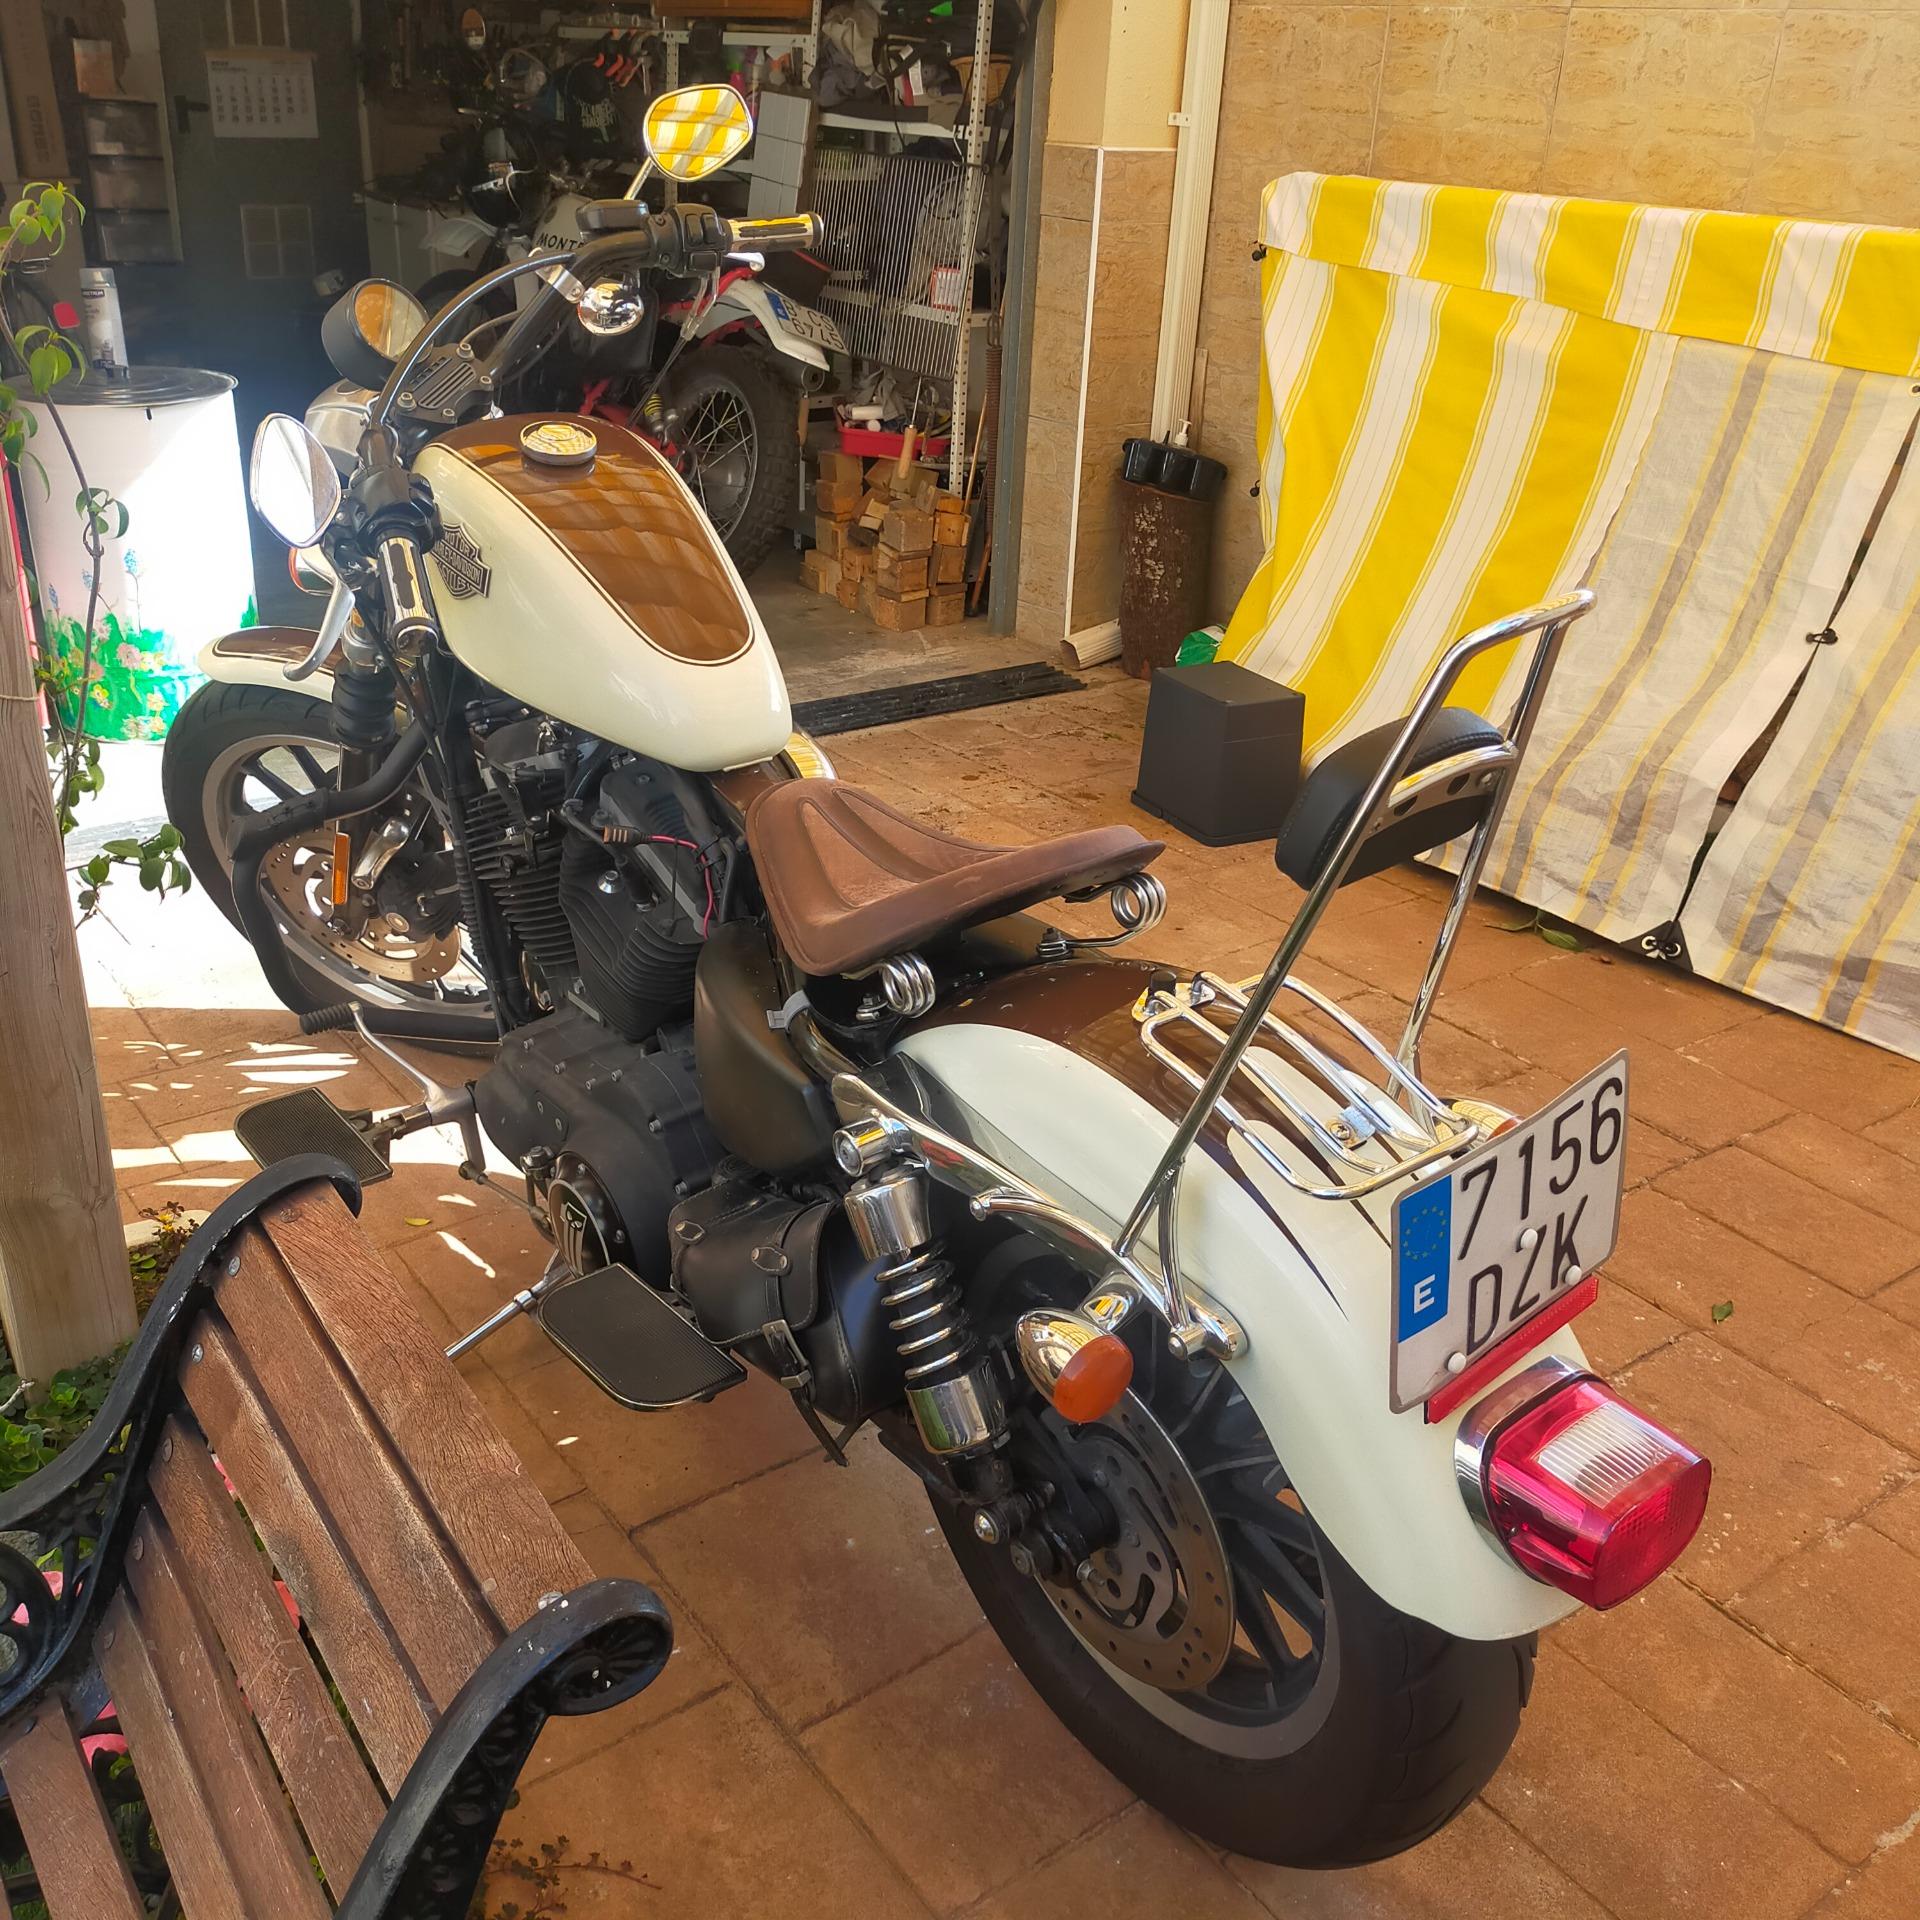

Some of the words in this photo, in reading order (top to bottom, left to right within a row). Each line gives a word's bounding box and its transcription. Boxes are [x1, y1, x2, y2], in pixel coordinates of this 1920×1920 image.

[792, 318, 844, 350] 6745
[807, 310, 834, 332] CS
[444, 531, 471, 558] MOTOR
[1458, 1077, 1622, 1260] 7156
[1467, 1195, 1588, 1355] DZK
[1413, 1273, 1436, 1315] E
